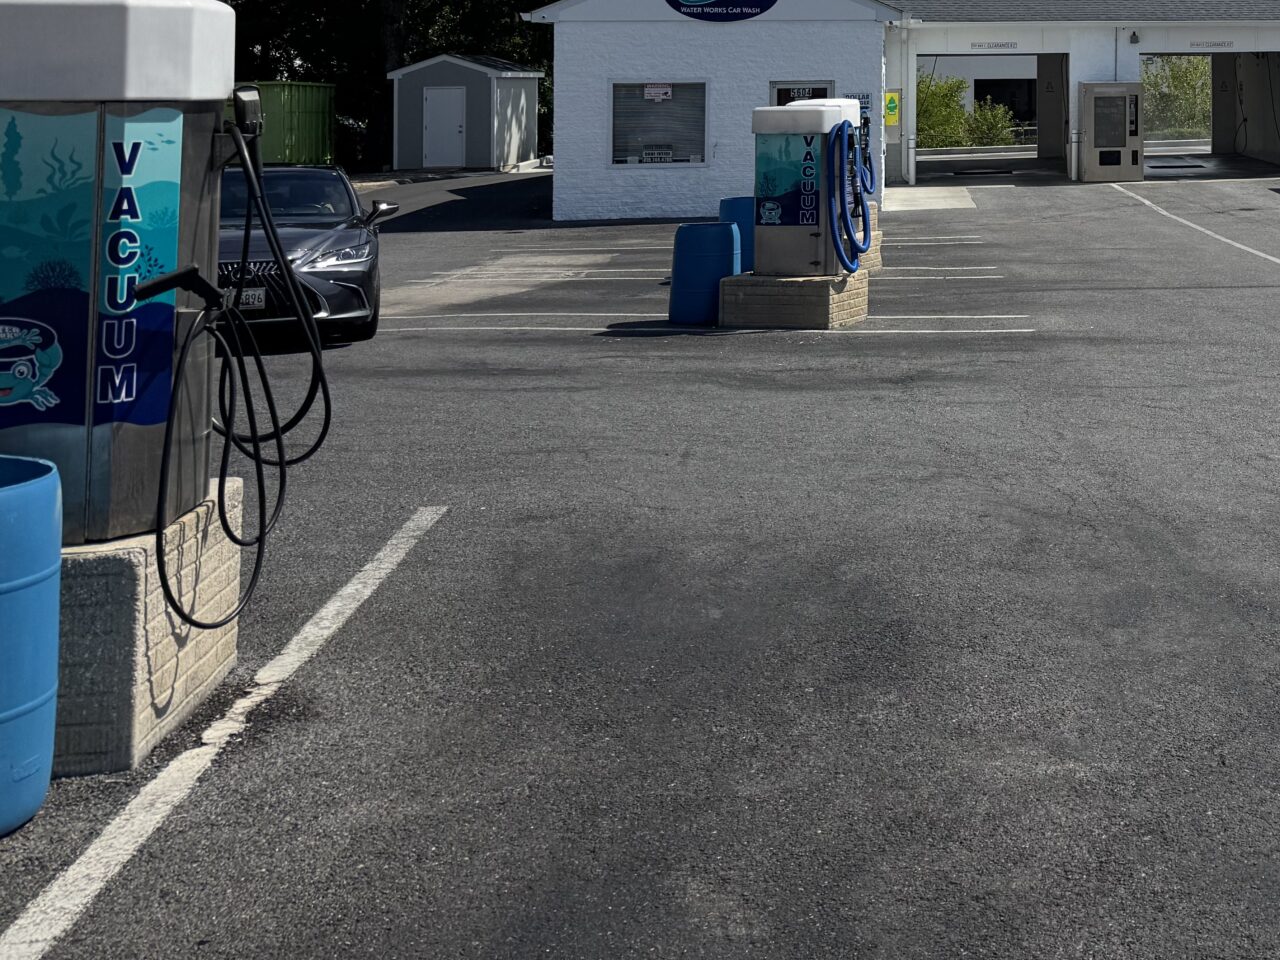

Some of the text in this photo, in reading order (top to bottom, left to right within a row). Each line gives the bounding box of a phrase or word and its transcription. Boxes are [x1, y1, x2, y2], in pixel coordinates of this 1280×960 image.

[703, 6, 727, 14] WORKS
[791, 88, 812, 97] 5604
[800, 135, 816, 224] VACUUM
[97, 140, 144, 405] VACUUM
